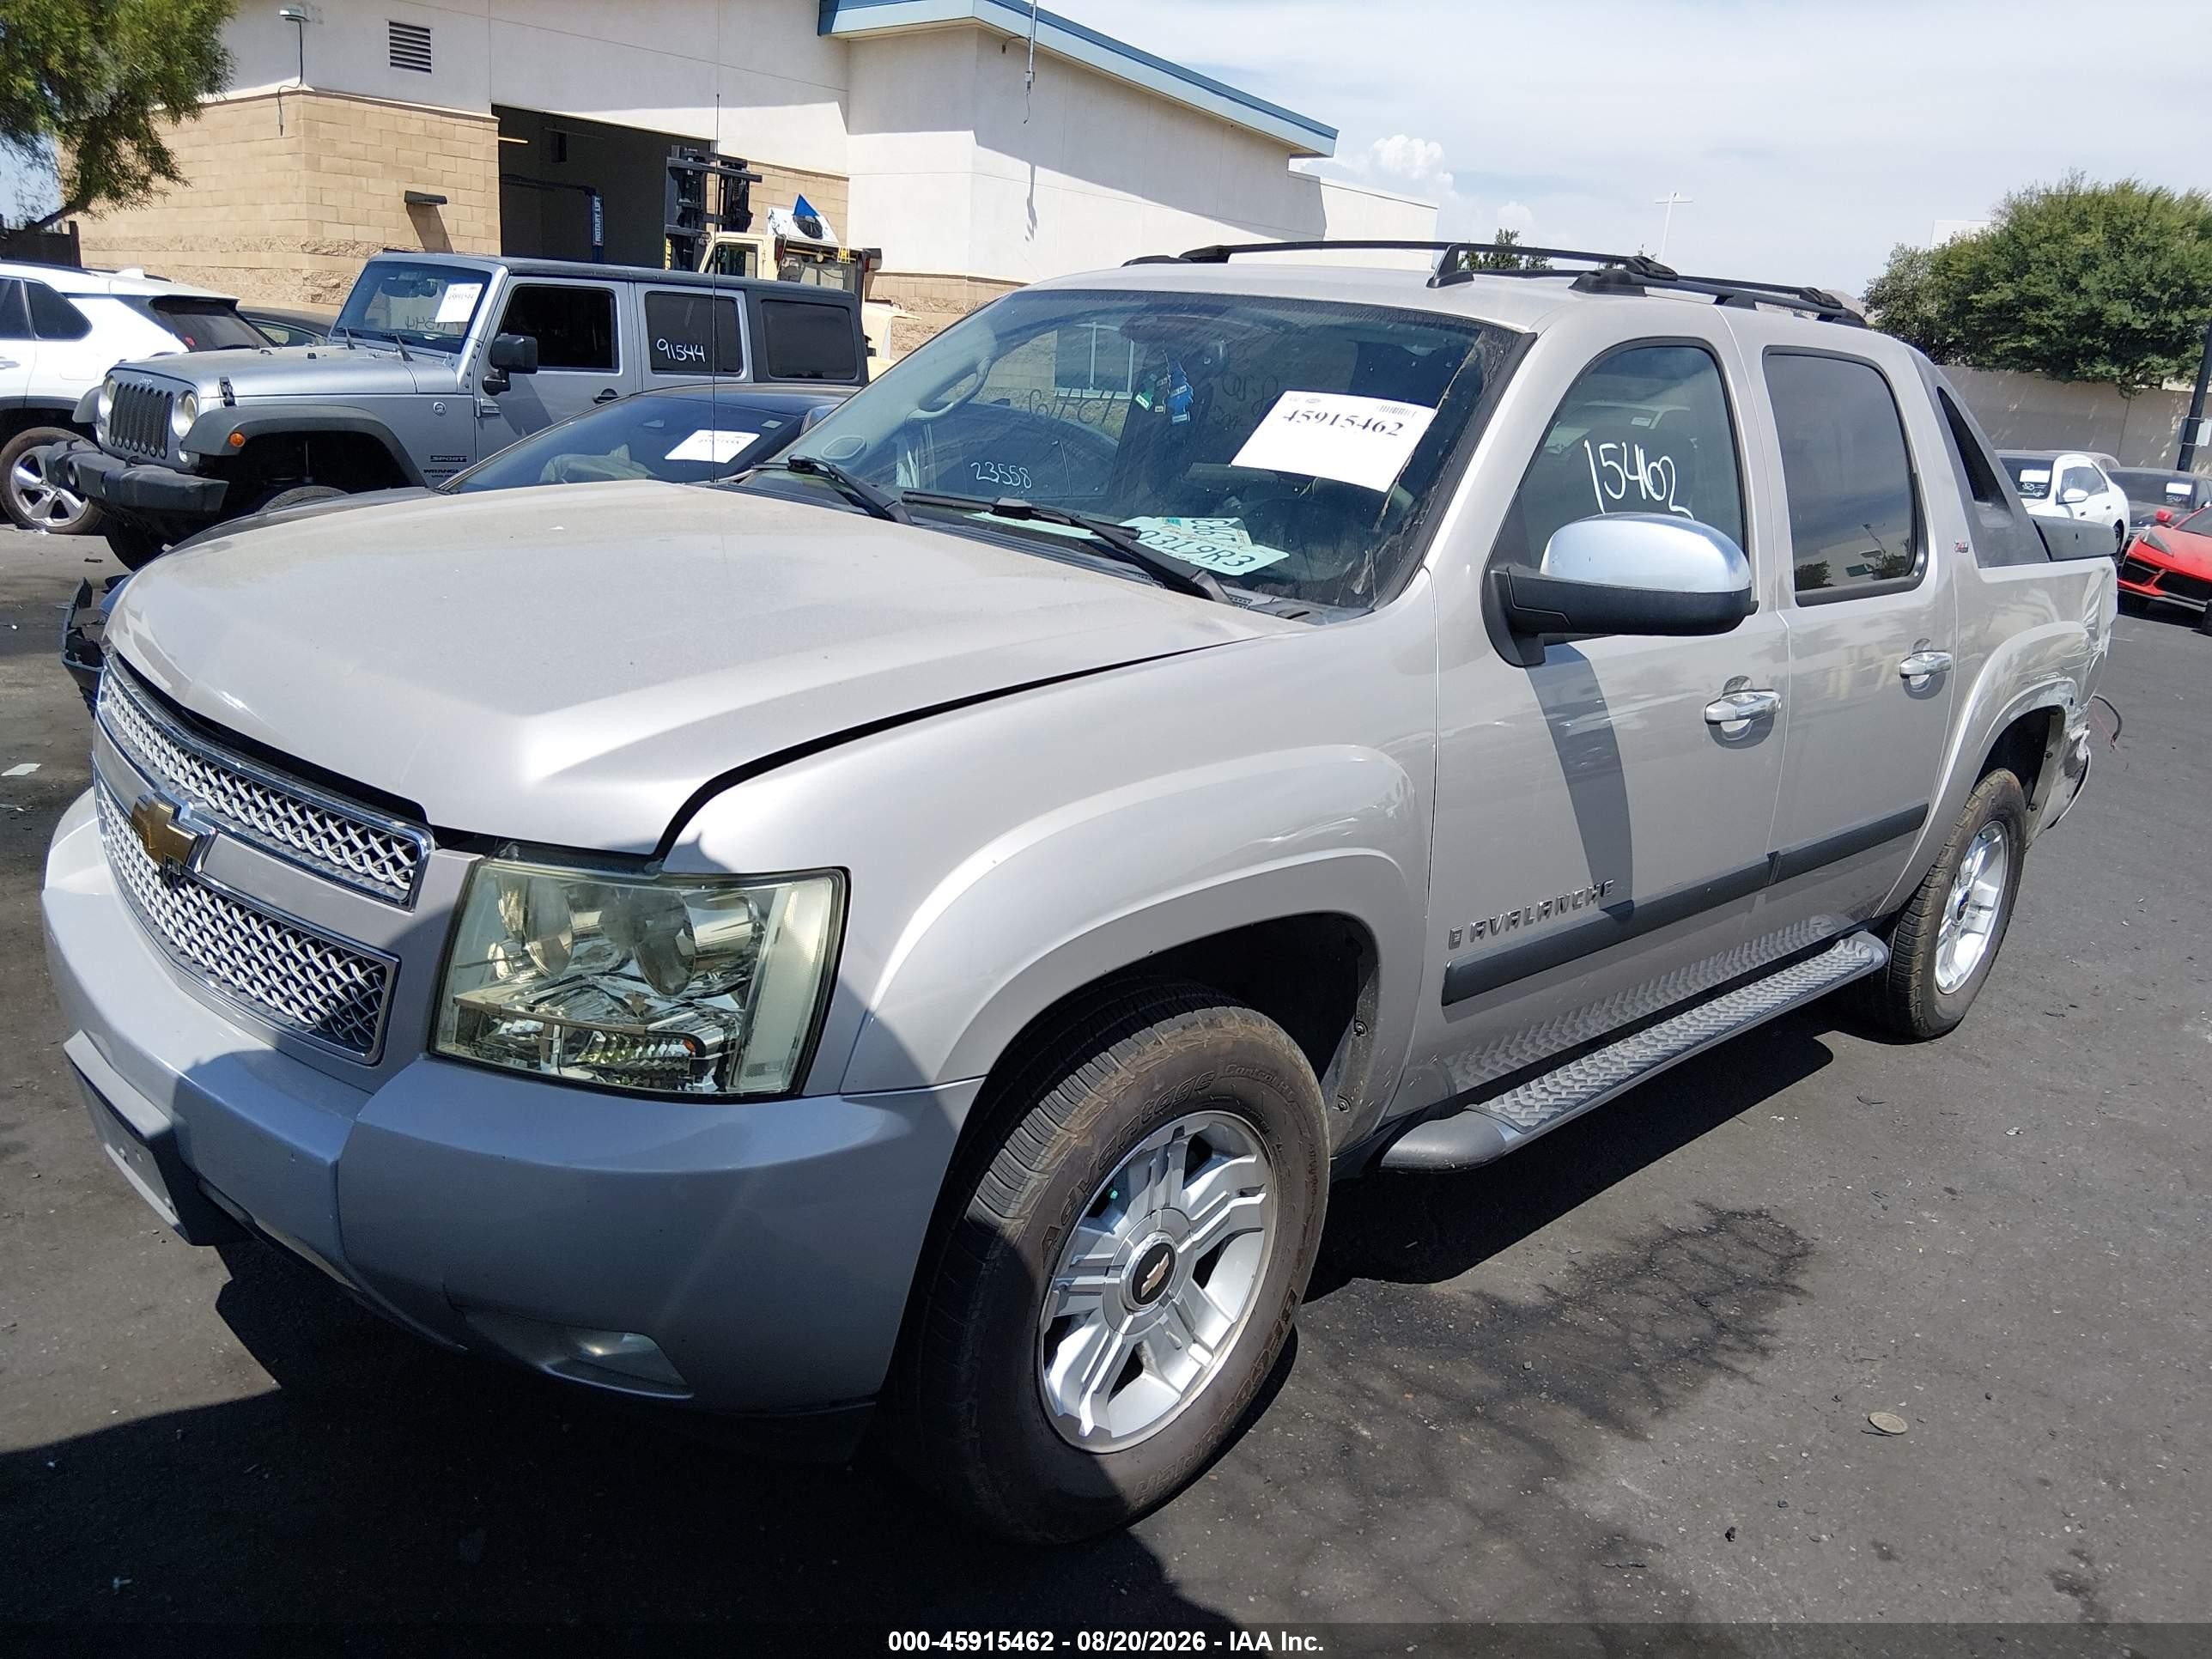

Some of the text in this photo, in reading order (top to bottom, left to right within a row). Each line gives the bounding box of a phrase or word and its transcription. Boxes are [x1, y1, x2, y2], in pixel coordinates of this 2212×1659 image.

[656, 337, 706, 363] 91544
[1283, 408, 1404, 437] 45915462
[969, 461, 1032, 489] 23558
[1583, 439, 1695, 522] 15462
[1127, 526, 1255, 567] 0319R3
[1469, 878, 1614, 944] AVALANCHE
[1224, 1063, 1278, 1085] Control
